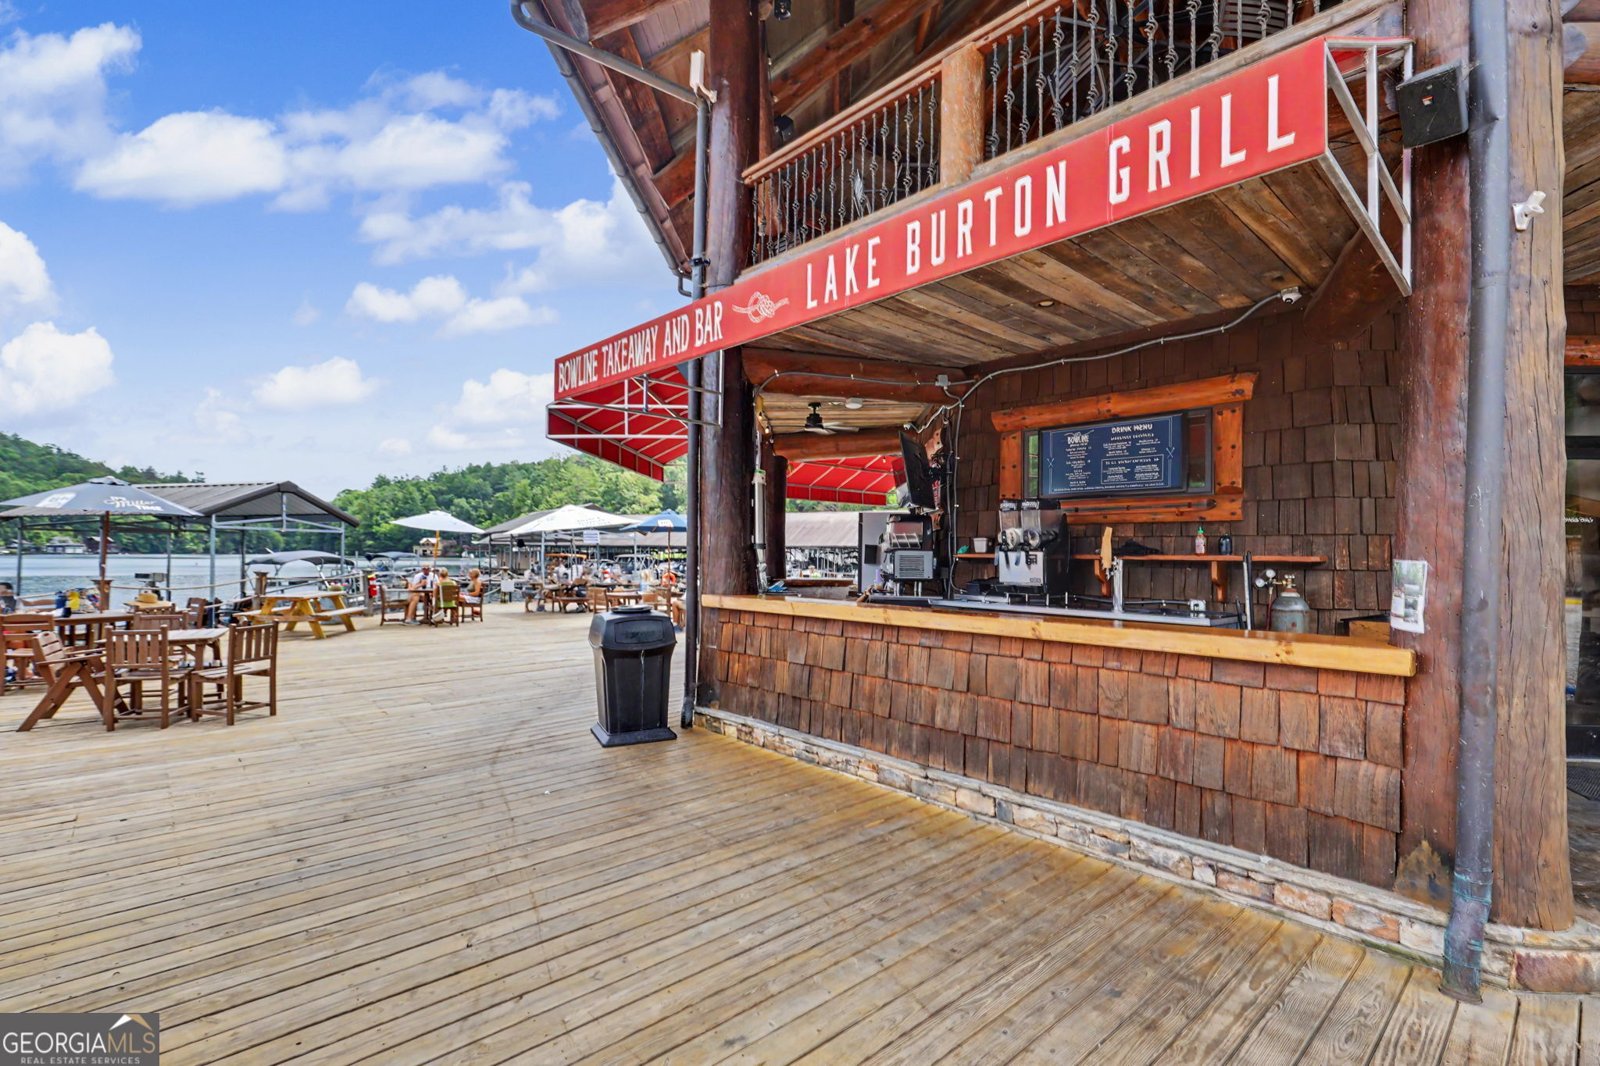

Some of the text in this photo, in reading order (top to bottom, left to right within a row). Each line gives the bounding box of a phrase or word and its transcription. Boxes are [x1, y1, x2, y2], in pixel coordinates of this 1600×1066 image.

[806, 74, 1297, 310] LAKE BURTON GRILL
[558, 300, 723, 393] BOWLINE TAKEAWAY AND BAR
[1111, 423, 1153, 434] DRINK MENU
